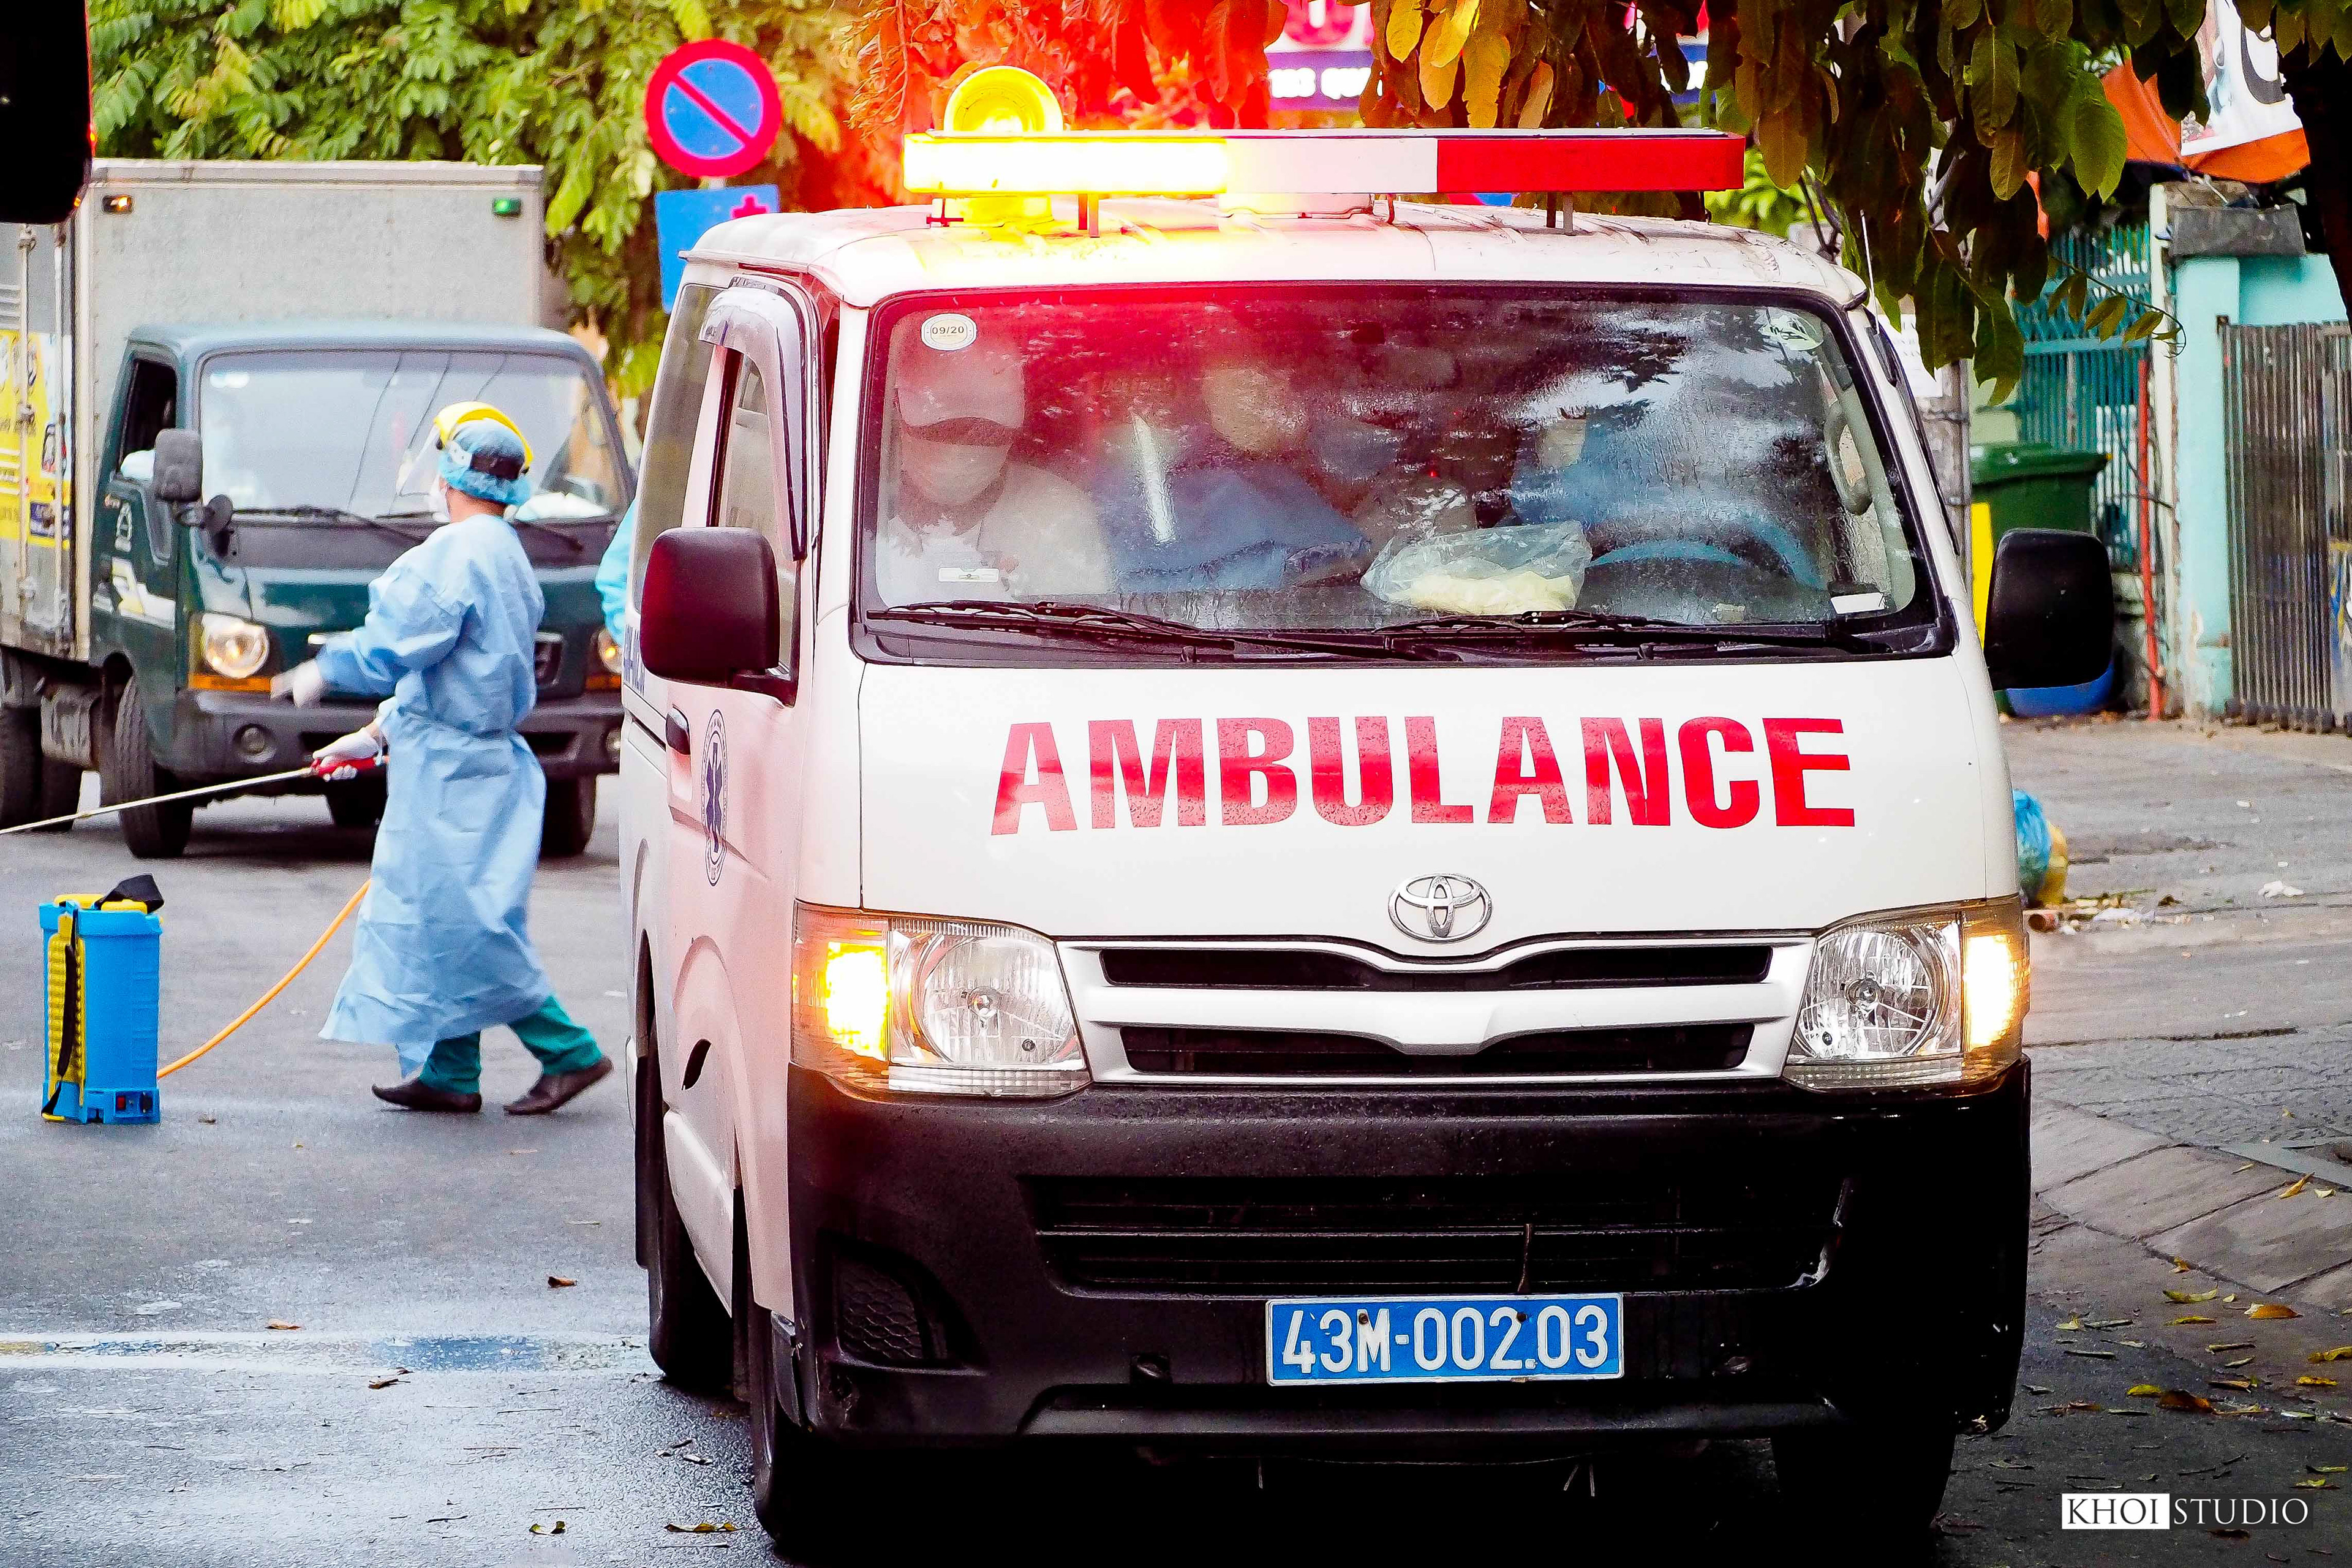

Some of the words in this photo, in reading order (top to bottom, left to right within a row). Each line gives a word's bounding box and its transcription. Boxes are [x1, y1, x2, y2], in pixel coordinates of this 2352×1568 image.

[932, 326, 964, 334] 09/20
[992, 715, 1856, 834] AMBULANCE
[1282, 1305, 1608, 1374] 43M-002.03
